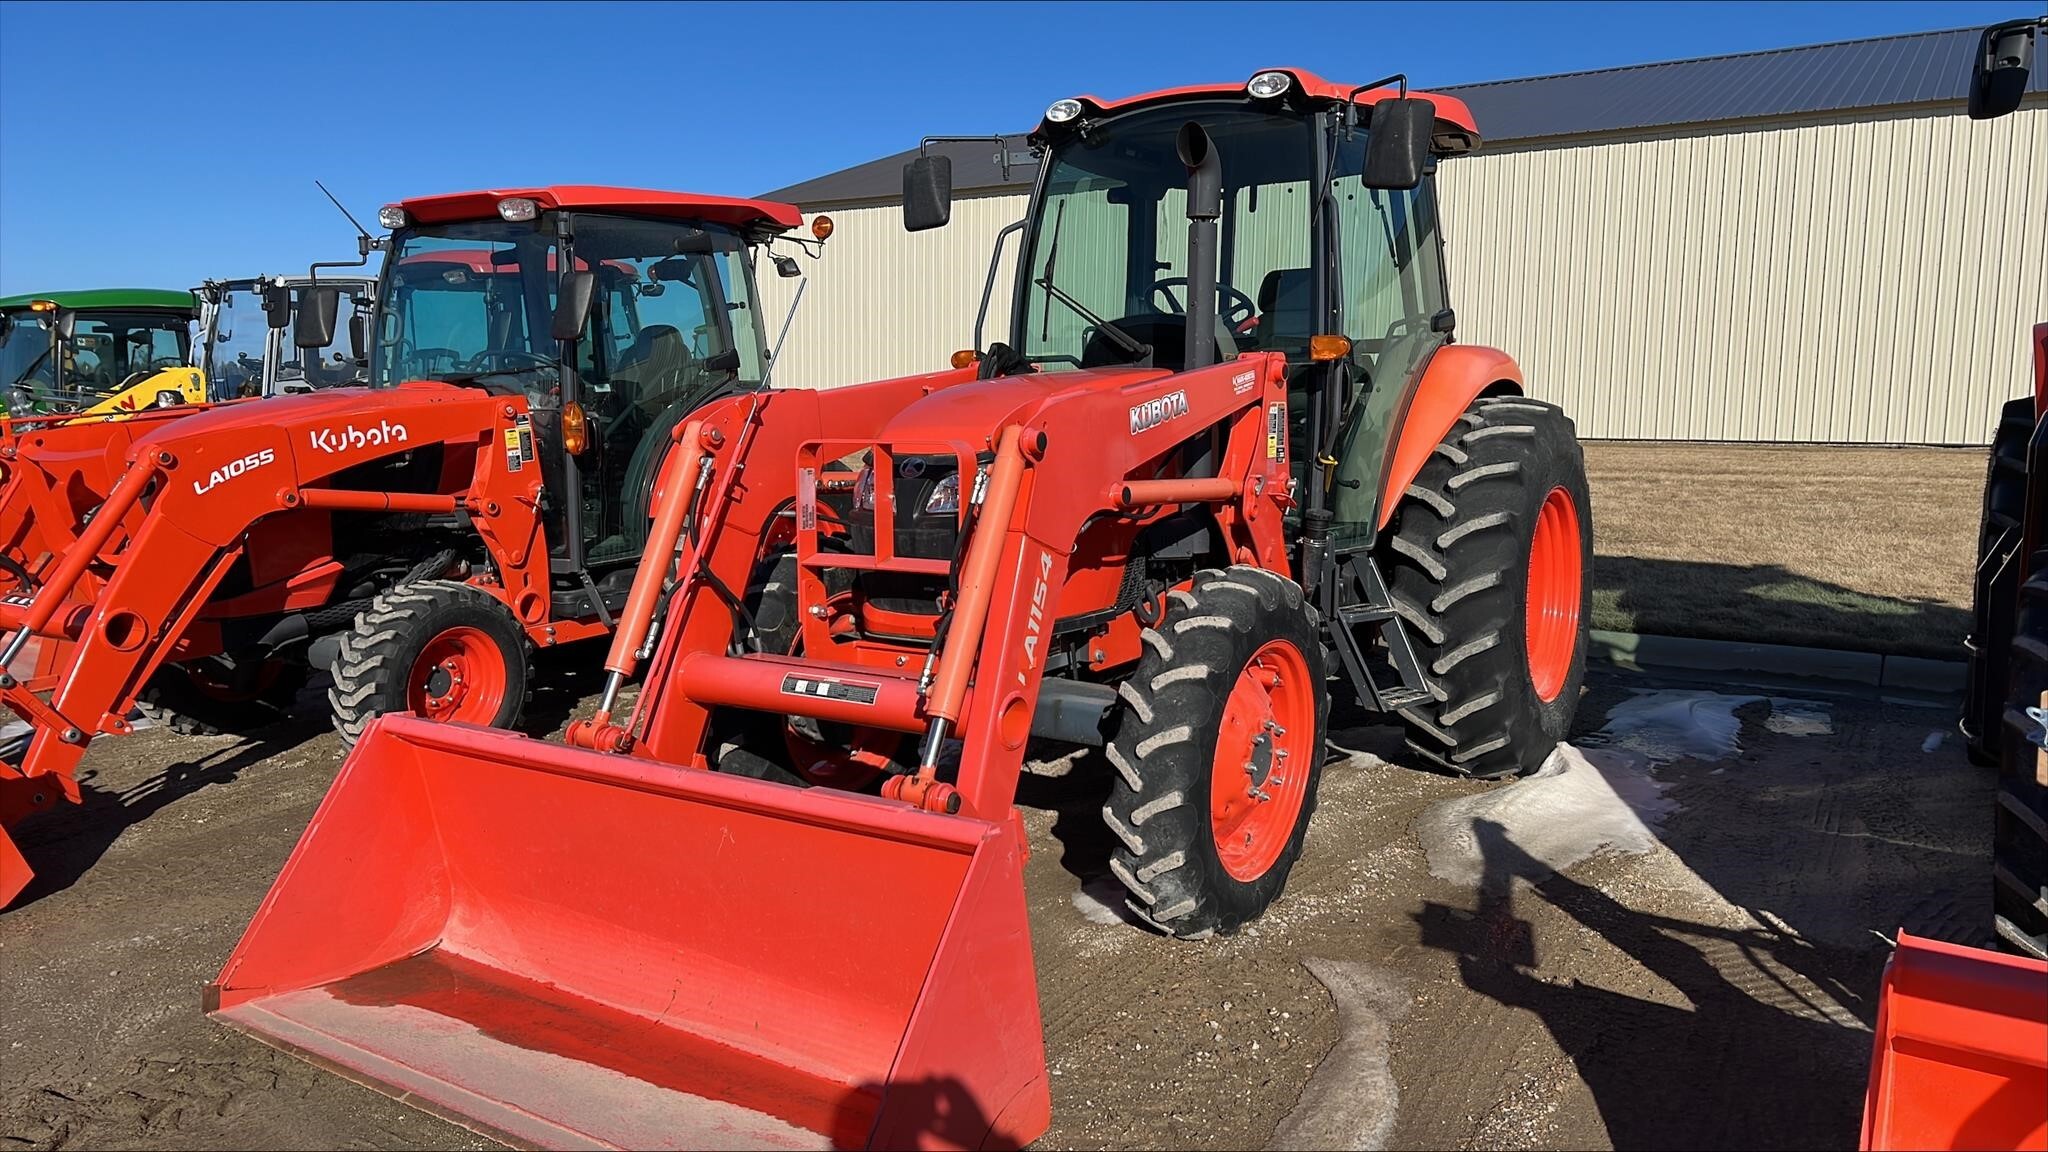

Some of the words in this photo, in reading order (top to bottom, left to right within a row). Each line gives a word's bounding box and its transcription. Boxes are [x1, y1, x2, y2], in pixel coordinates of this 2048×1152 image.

[1130, 390, 1190, 435] KUBOTA
[310, 420, 408, 453] Kubota
[193, 448, 275, 495] LA1055
